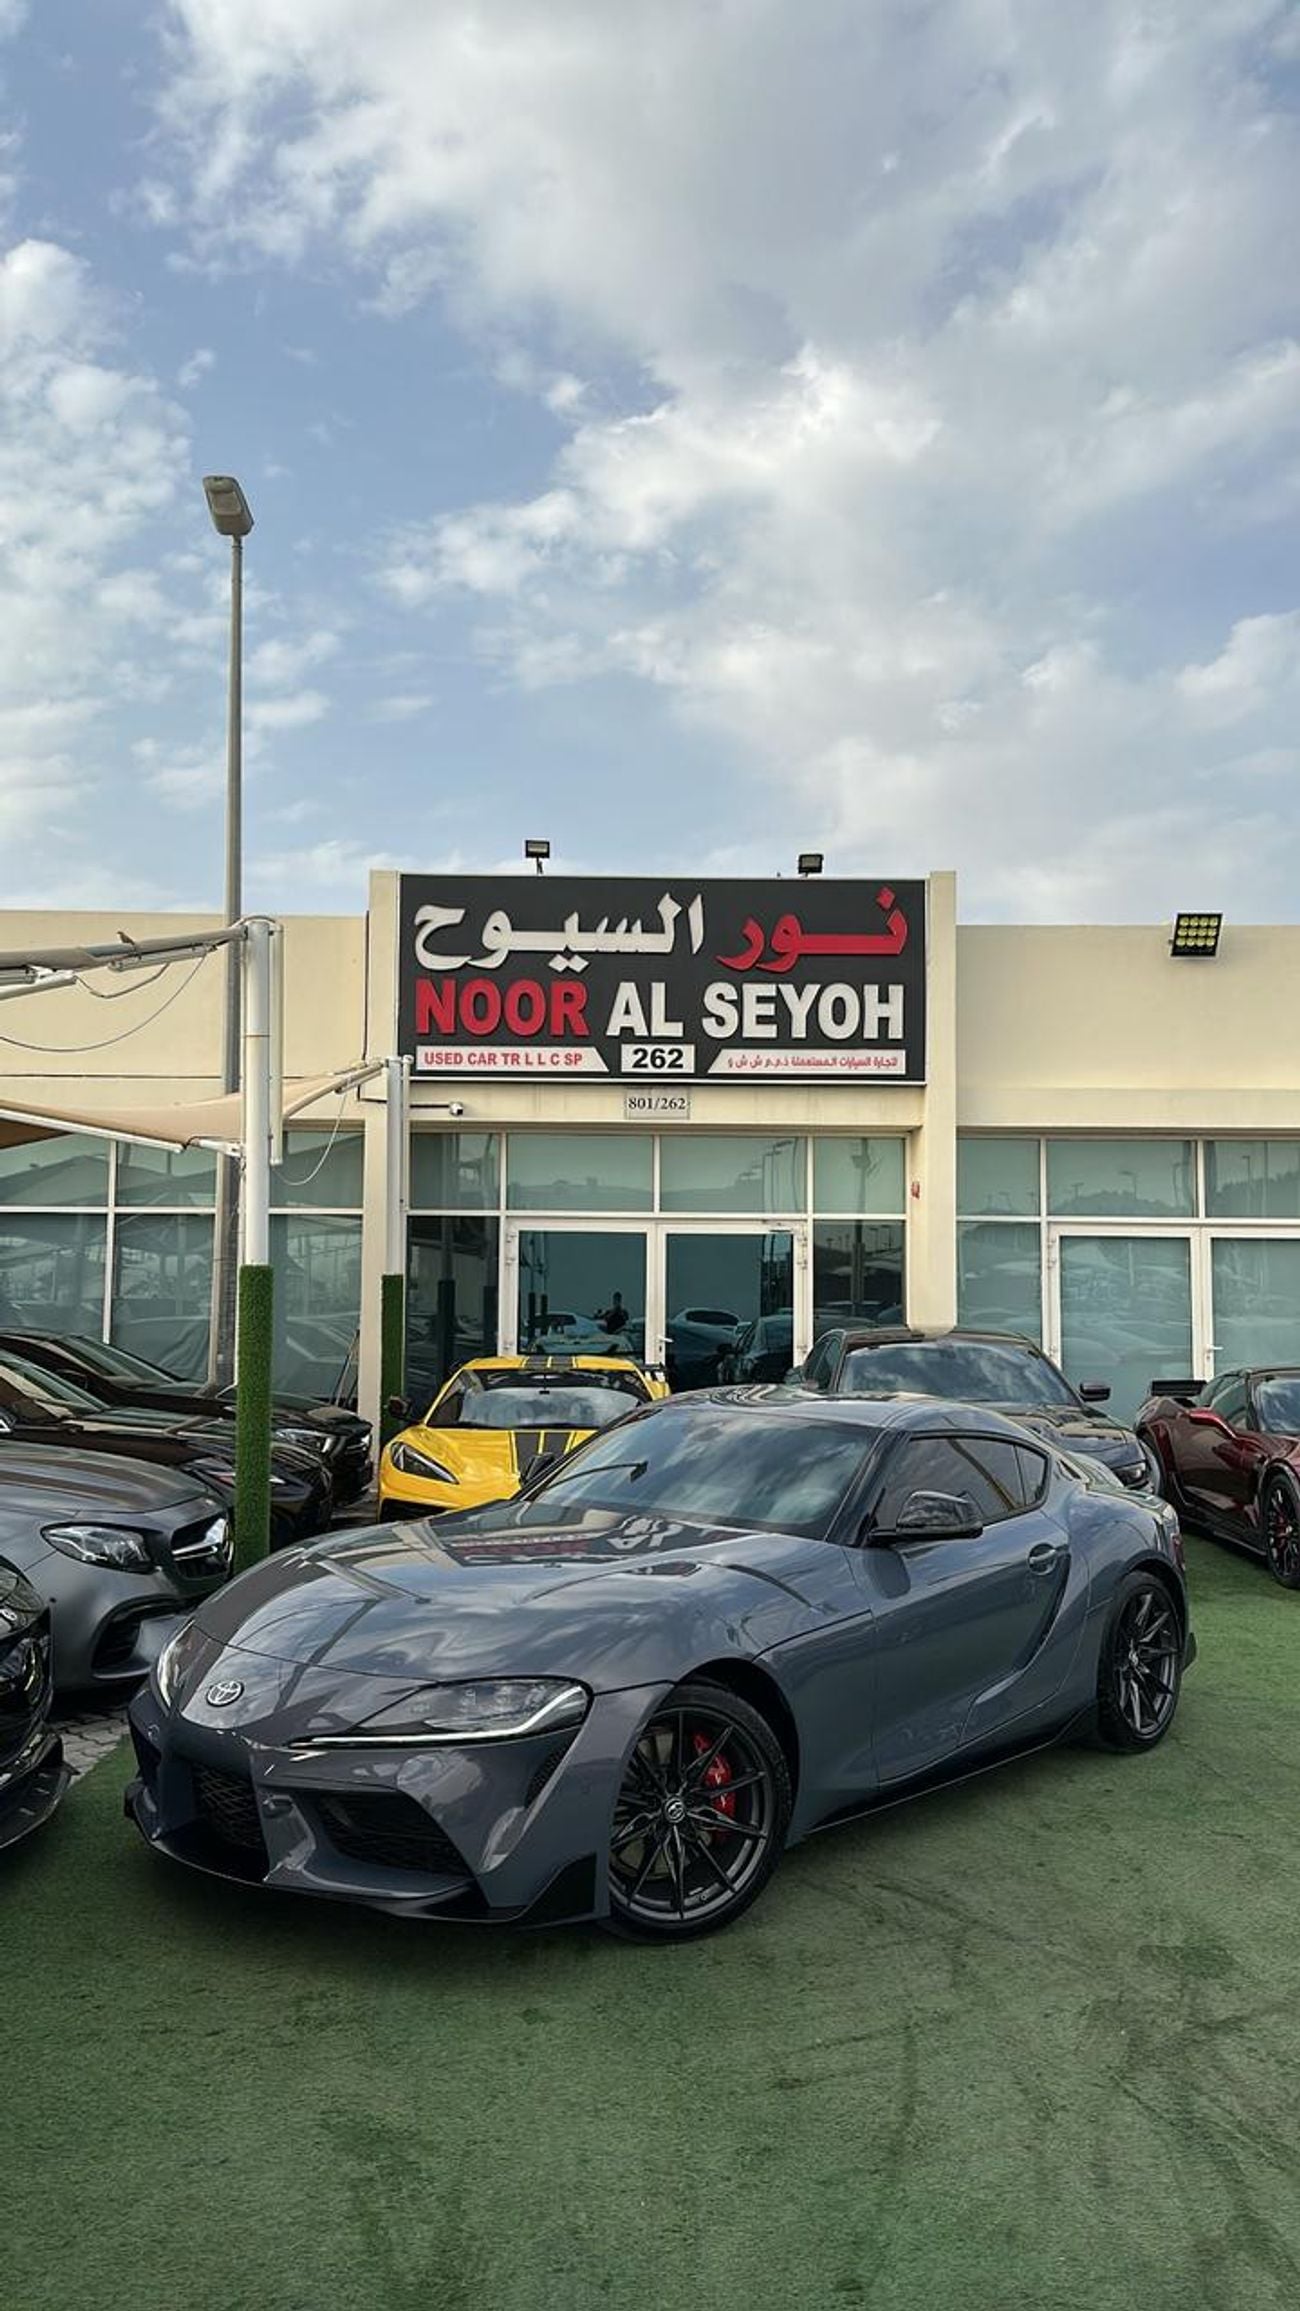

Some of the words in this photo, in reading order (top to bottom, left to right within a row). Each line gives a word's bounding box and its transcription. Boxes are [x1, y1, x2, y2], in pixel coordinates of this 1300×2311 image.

[414, 892, 704, 972] السيوح
[715, 886, 908, 973] نور
[415, 977, 590, 1037] NOOR
[605, 981, 684, 1038] AL
[702, 981, 905, 1040] SEYOH
[424, 1052, 463, 1065] USED
[467, 1052, 497, 1065] CAR
[502, 1053, 520, 1065] TR
[525, 1053, 533, 1065] L
[538, 1053, 545, 1065] L
[550, 1053, 561, 1066] C
[564, 1053, 583, 1066] SP
[631, 1047, 684, 1069] 262
[791, 1056, 838, 1068] المستعملة
[839, 1056, 871, 1070] السيارات
[628, 1096, 687, 1111] 801/262
